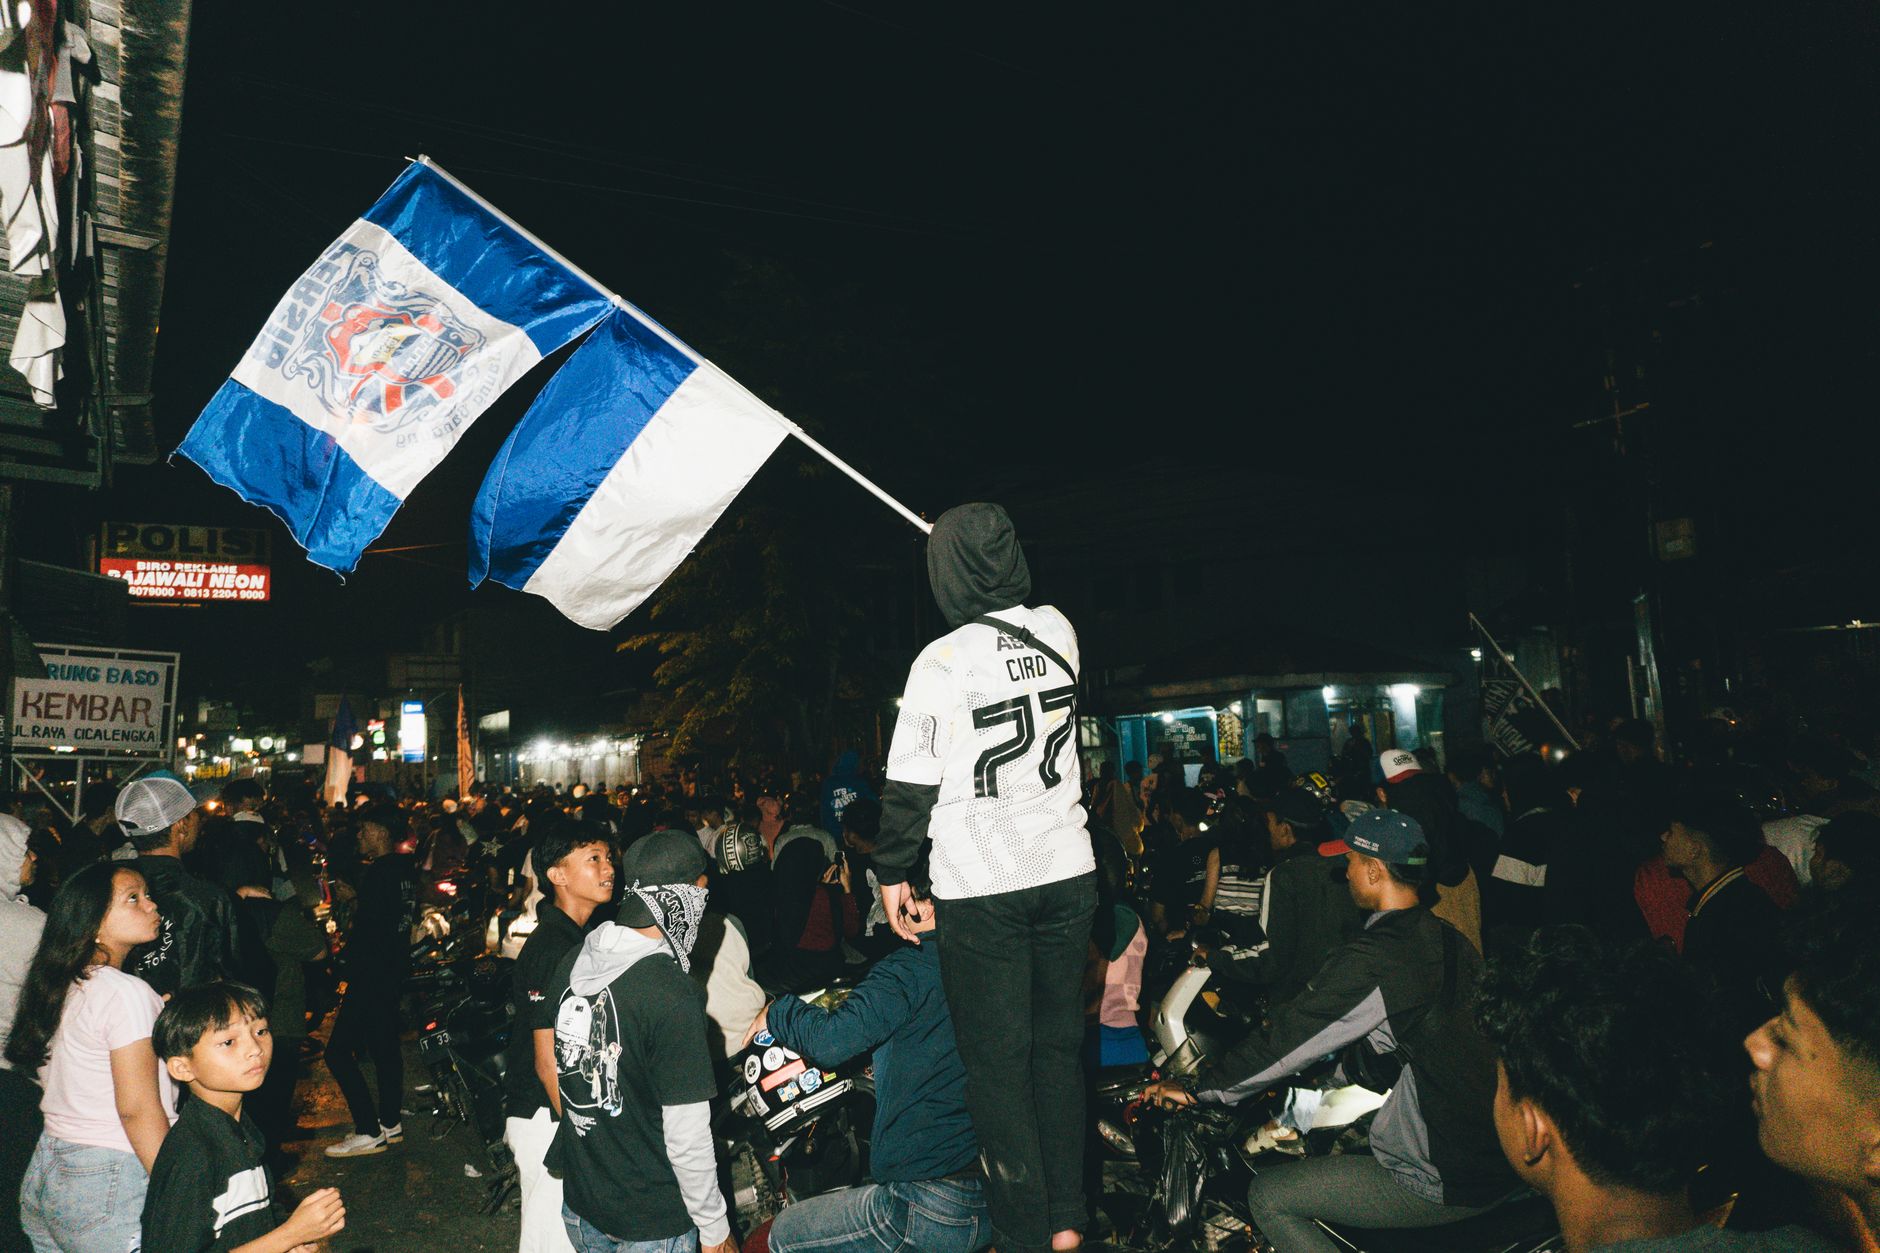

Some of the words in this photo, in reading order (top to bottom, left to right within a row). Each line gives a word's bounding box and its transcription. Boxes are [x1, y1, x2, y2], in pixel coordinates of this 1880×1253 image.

[107, 523, 266, 557] POLISI
[136, 561, 171, 572] BIRO
[174, 563, 238, 574] REKLAME
[209, 573, 265, 590] NEON
[184, 588, 210, 599] 0813
[212, 588, 238, 599] 2204
[240, 589, 265, 600] 9000
[106, 667, 160, 687] BASO
[21, 690, 154, 728] KEMBAR
[74, 728, 156, 743] CICALENGKA
[971, 684, 1077, 798] 77
